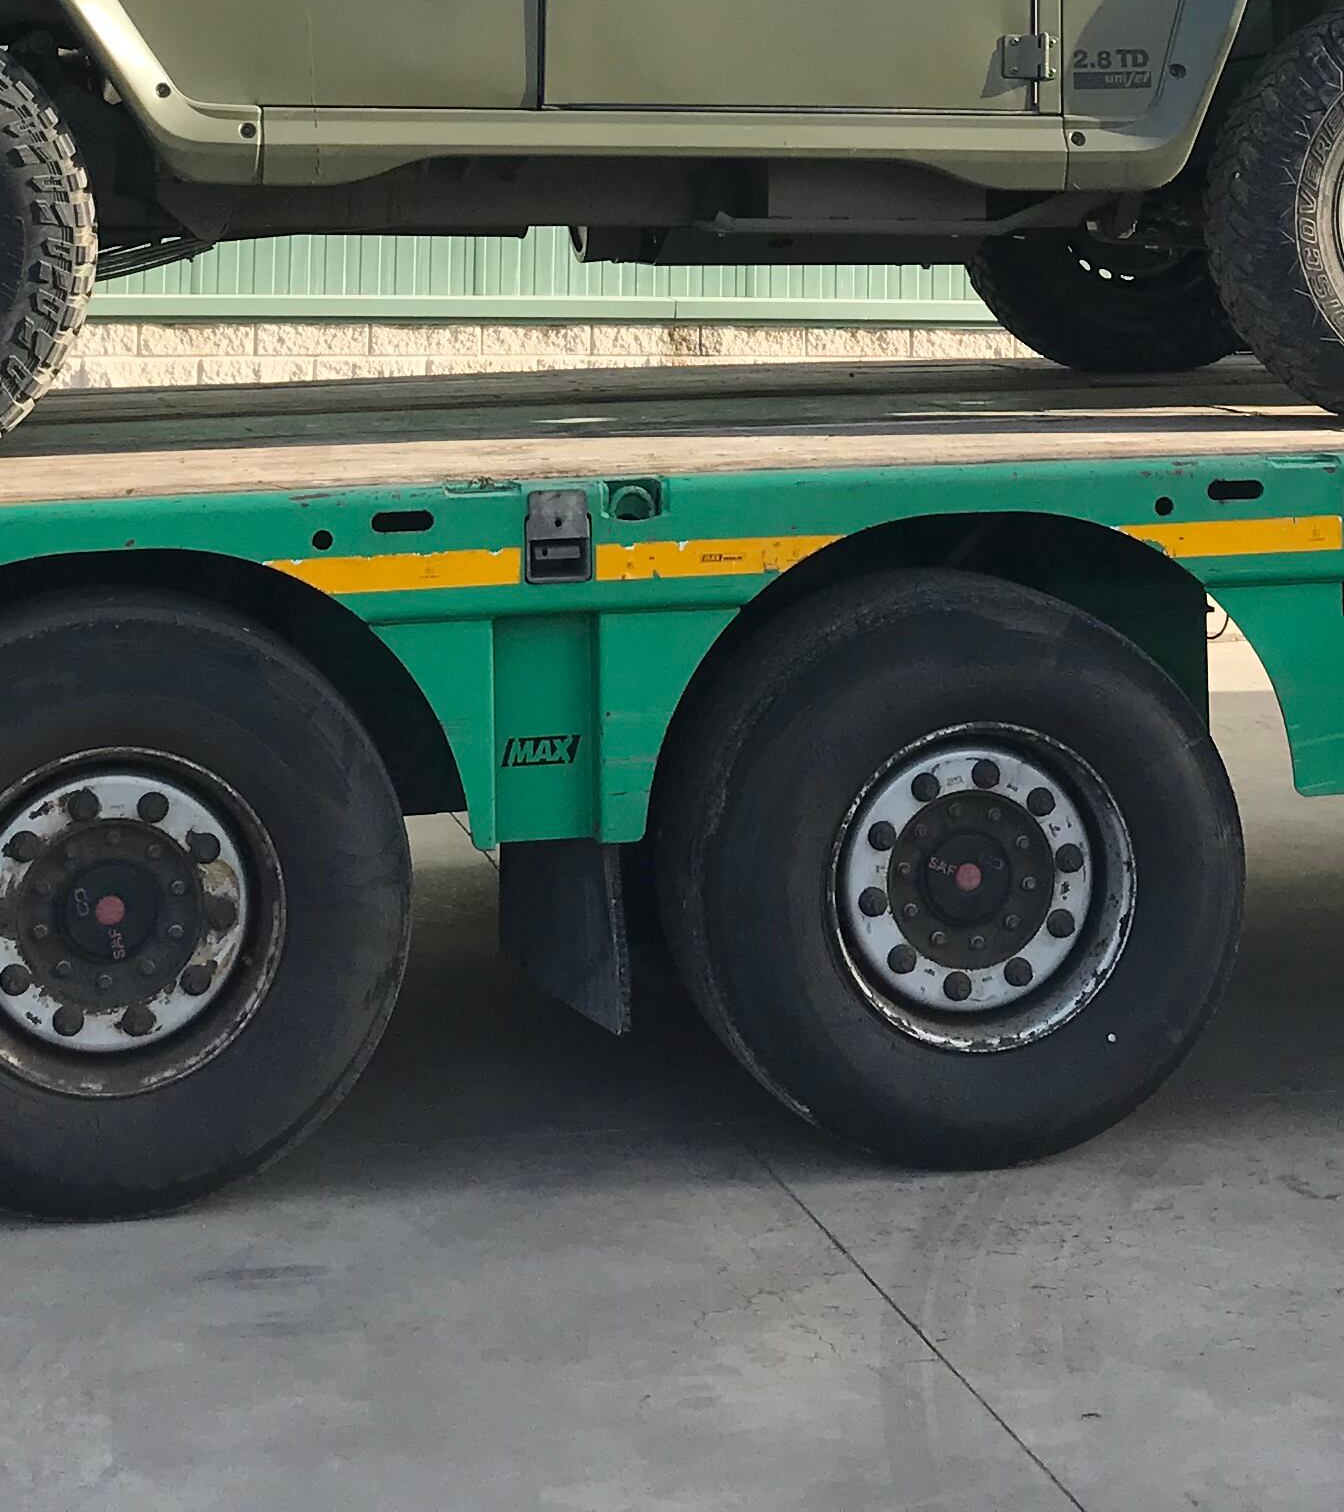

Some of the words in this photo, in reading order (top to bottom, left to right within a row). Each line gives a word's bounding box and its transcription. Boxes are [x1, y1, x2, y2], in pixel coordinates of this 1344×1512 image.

[1073, 49, 1112, 69] 2.8
[1116, 49, 1150, 68] TD
[508, 736, 572, 765] MAX
[928, 856, 957, 875] SAF
